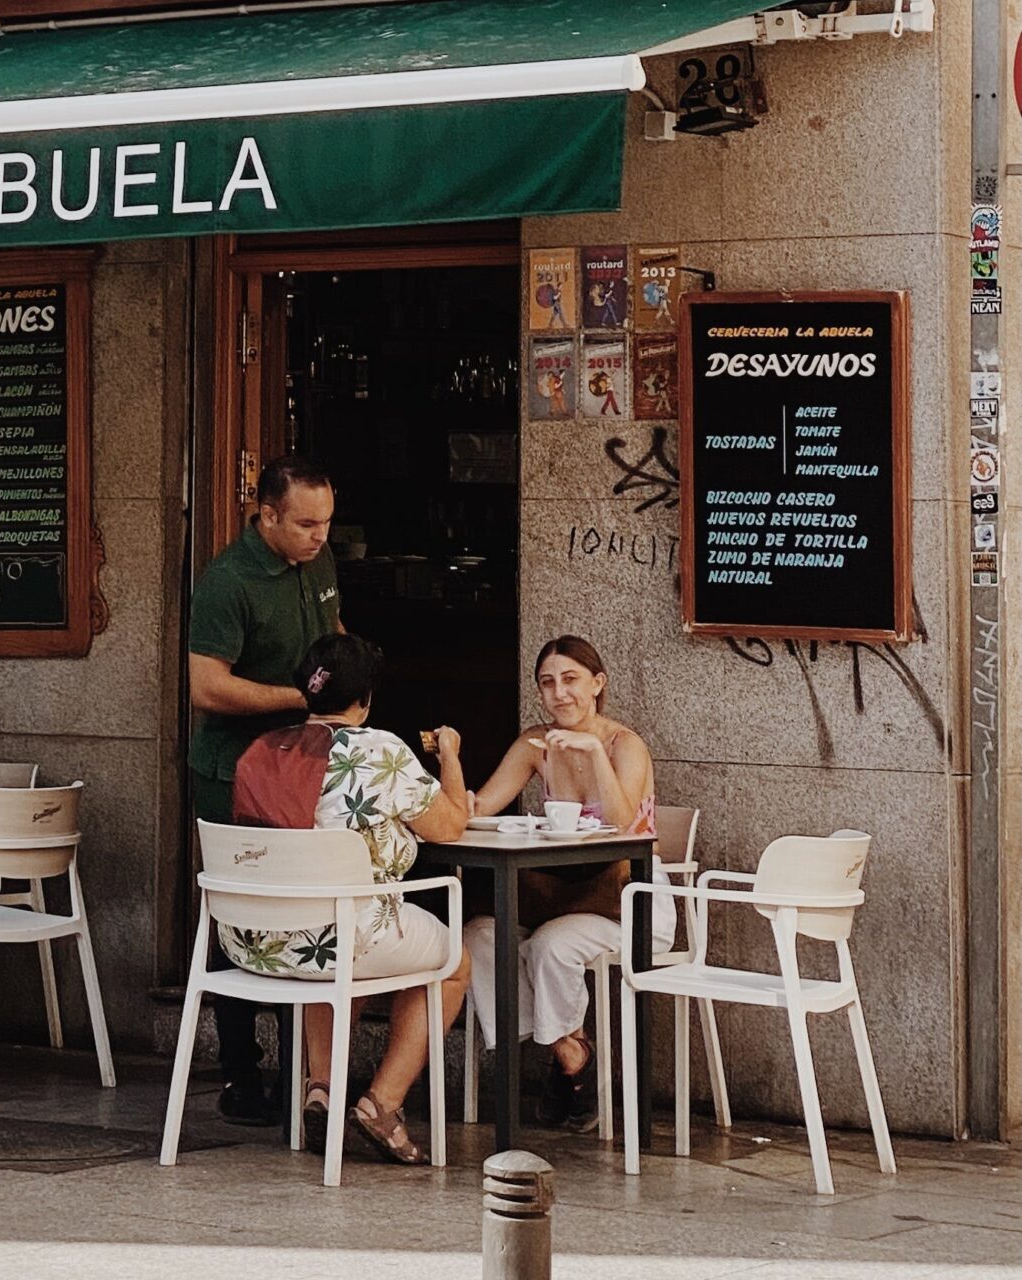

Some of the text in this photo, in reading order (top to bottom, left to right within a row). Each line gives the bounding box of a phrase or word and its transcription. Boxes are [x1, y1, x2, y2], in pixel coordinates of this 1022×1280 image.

[679, 54, 741, 108] 28
[534, 261, 571, 271] routard
[587, 260, 623, 269] routard
[641, 267, 676, 278] 2013
[14, 288, 57, 299] ABUELA
[707, 325, 873, 338] CERVECERIA LA ABUELA
[588, 357, 622, 369] 2015
[705, 352, 876, 378] DESAYUNOS
[795, 406, 837, 418] ACEITE
[795, 425, 841, 438] TOMATE
[705, 435, 776, 449] TOSTADAS
[795, 442, 837, 457] JAMÓN
[795, 464, 879, 479] MANTEQUILLA
[706, 490, 836, 507] BIZCOCHO CASERO
[707, 511, 857, 529] HUEVOS REVUELTOS
[707, 531, 868, 550] PINCHO DE TORTILLA
[707, 550, 845, 568] ZUMO DE NARANJA
[708, 570, 773, 585] NATURAL
